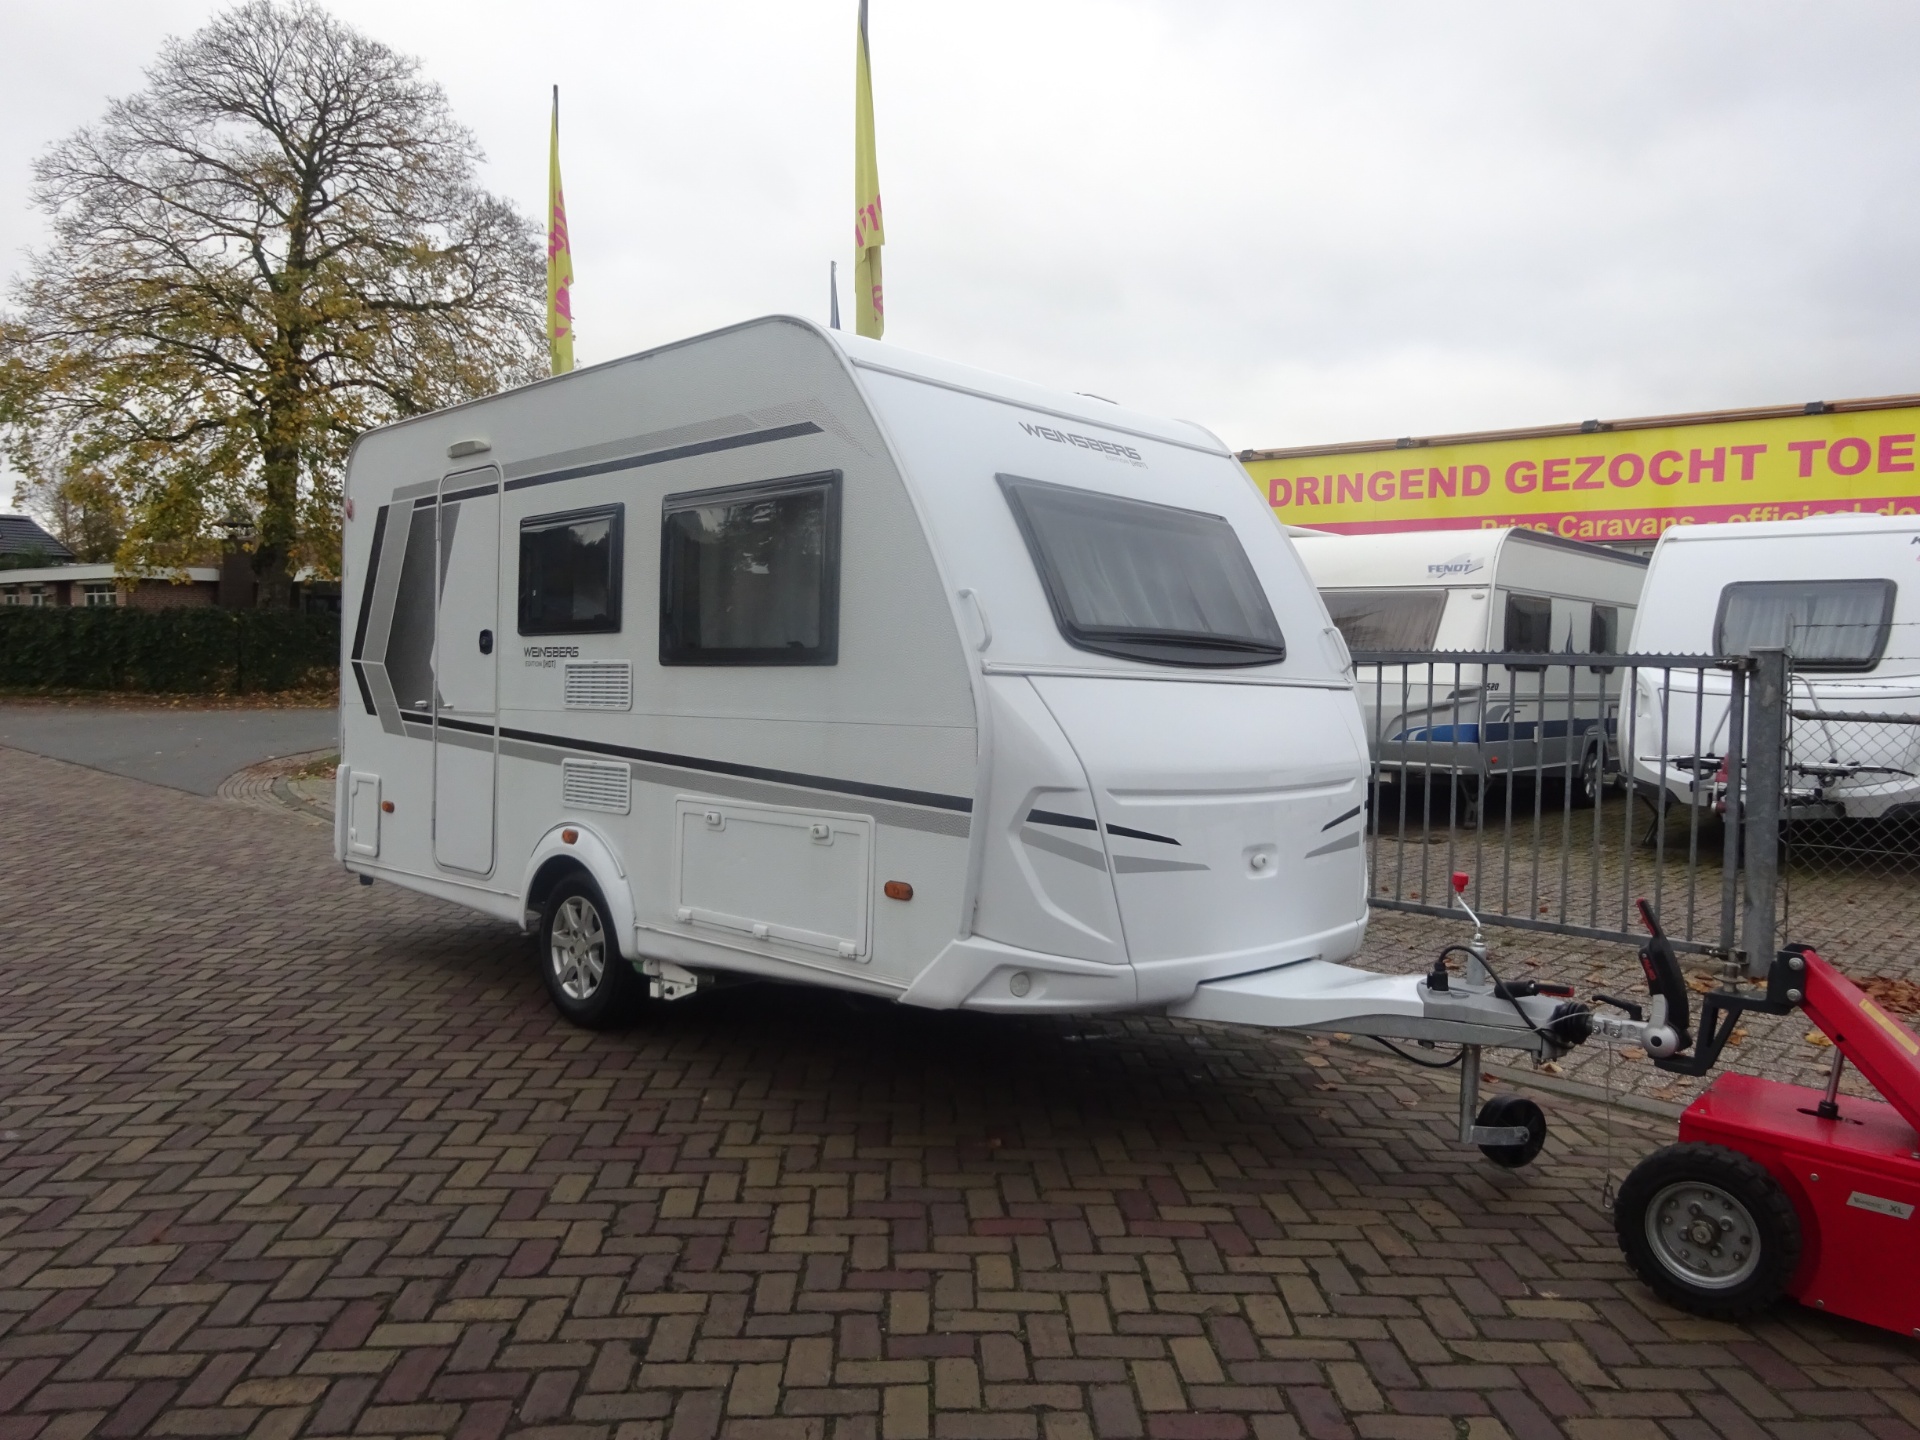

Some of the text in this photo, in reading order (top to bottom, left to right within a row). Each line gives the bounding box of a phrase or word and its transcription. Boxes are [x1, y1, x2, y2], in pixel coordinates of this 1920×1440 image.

[1018, 421, 1142, 460] WEINSBERG
[1268, 433, 1917, 508] DRINGEND GEZOCHT TOE
[1557, 515, 1696, 538] Caravans
[1427, 562, 1472, 573] FENDT
[523, 646, 580, 658] WEINSBERG
